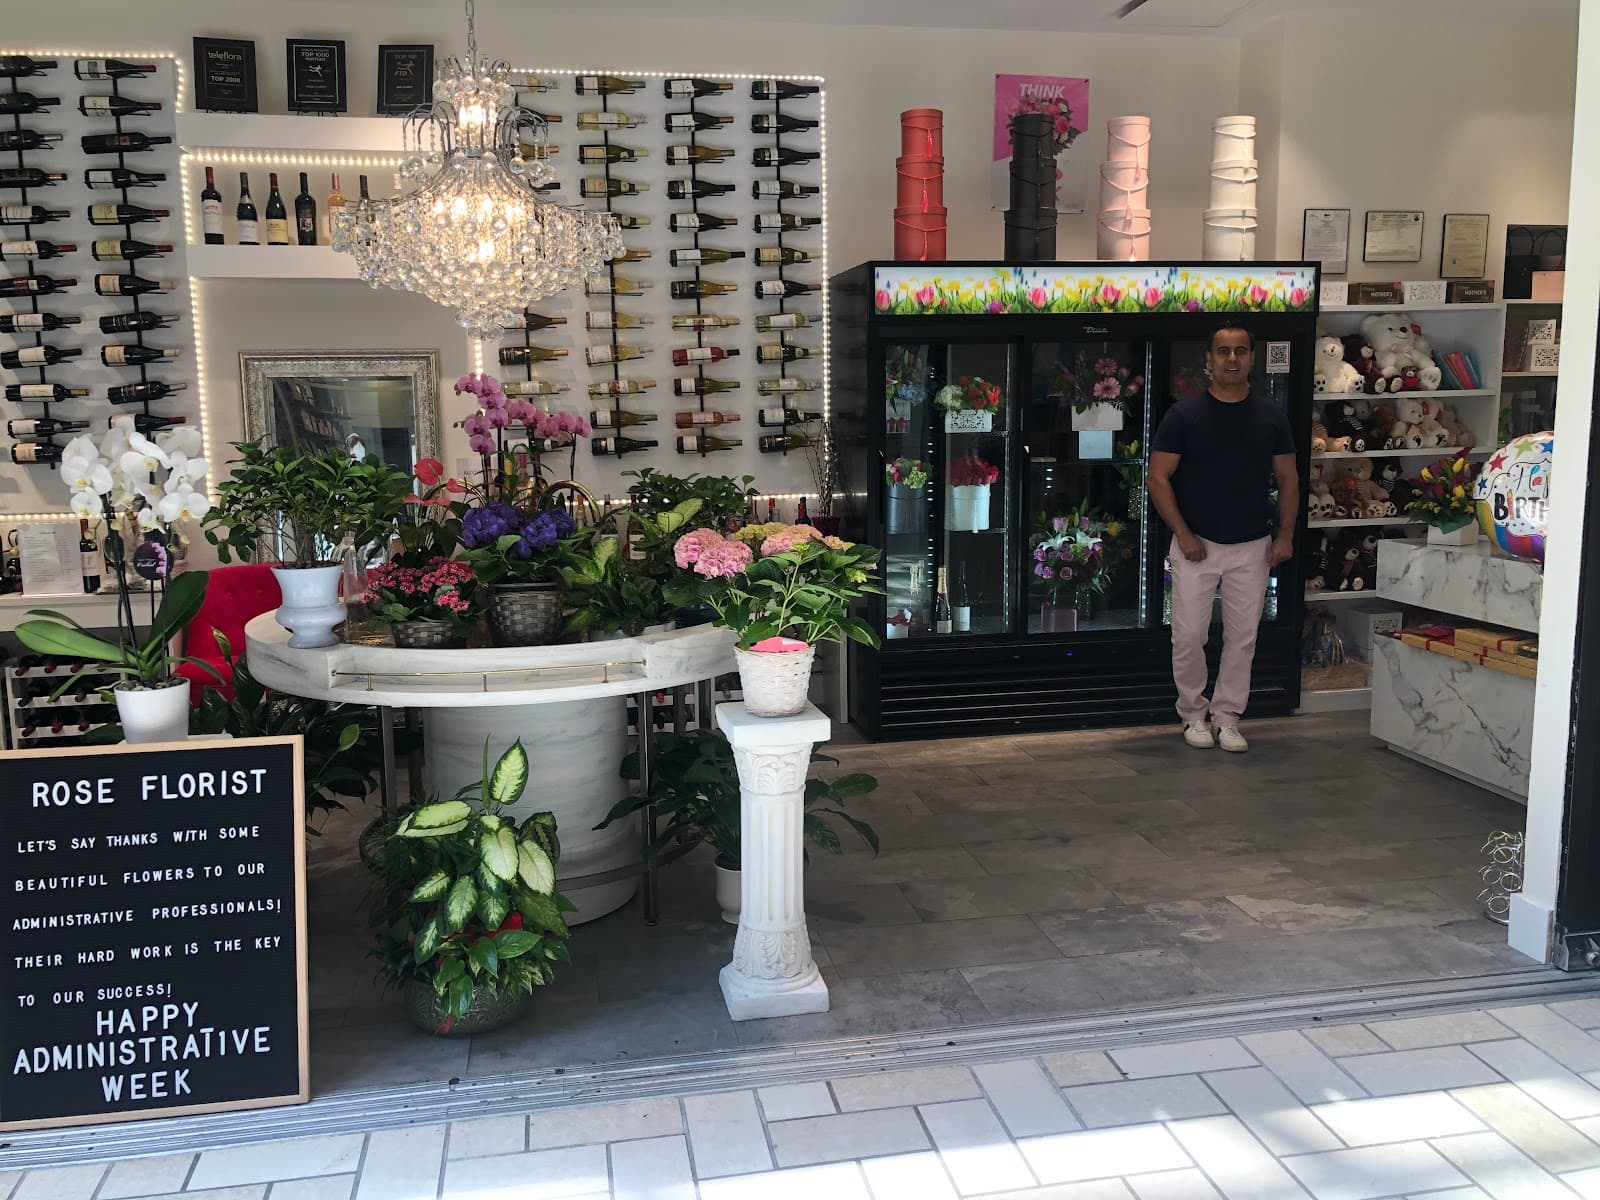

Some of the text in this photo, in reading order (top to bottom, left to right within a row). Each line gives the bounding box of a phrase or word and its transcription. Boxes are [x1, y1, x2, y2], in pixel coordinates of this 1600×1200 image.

[208, 51, 242, 61] teleflora
[1020, 83, 1066, 99] THINK
[33, 768, 267, 807] ROSE FLORIST
[17, 825, 260, 854] LET'S SAY THANKS WITH SOME
[15, 862, 265, 893] BEAUTIFUL FLOWERS TO OUR
[12, 898, 282, 931] ADMINISTRATIVE PROFESSIONALS!
[14, 935, 282, 969] THEIR HARD WORK IS THE KEY
[17, 983, 172, 1008] TO OUR SUCCESS!
[96, 1001, 199, 1036] HAPPY
[101, 1068, 192, 1103] WEEK
